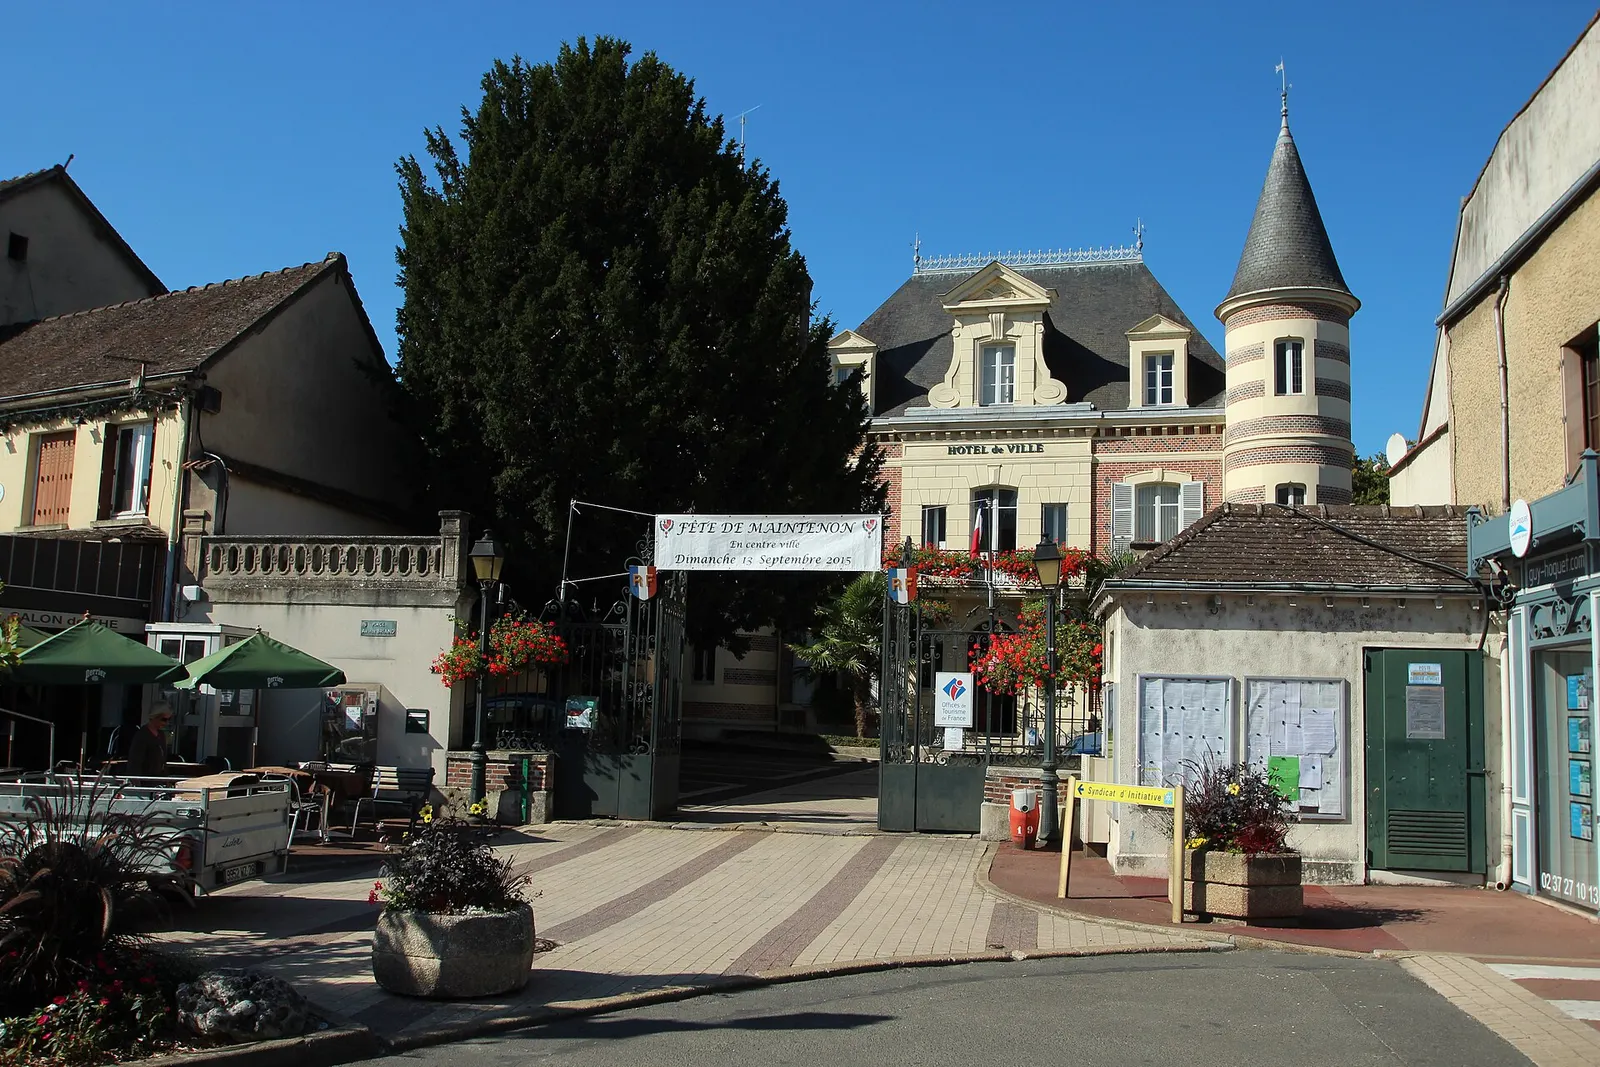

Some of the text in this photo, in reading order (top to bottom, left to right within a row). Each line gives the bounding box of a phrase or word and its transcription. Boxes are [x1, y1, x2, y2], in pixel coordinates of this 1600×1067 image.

[948, 443, 1045, 455] HOTEL de VILLE
[721, 522, 744, 534] DE
[747, 521, 857, 534] MAINTENON
[730, 539, 800, 549] En centre ville
[674, 553, 852, 568] Dimanche 13 Septembre 2015
[1528, 554, 1585, 587] guy-hoquet.com
[633, 573, 654, 588] RF
[891, 577, 913, 592] RF
[941, 701, 960, 709] Offices
[942, 708, 967, 716] Tourisme
[947, 714, 967, 722] France
[1087, 786, 1162, 802] Syndicat d'Initiative
[1541, 872, 1599, 905] 02 37 27 10 13
